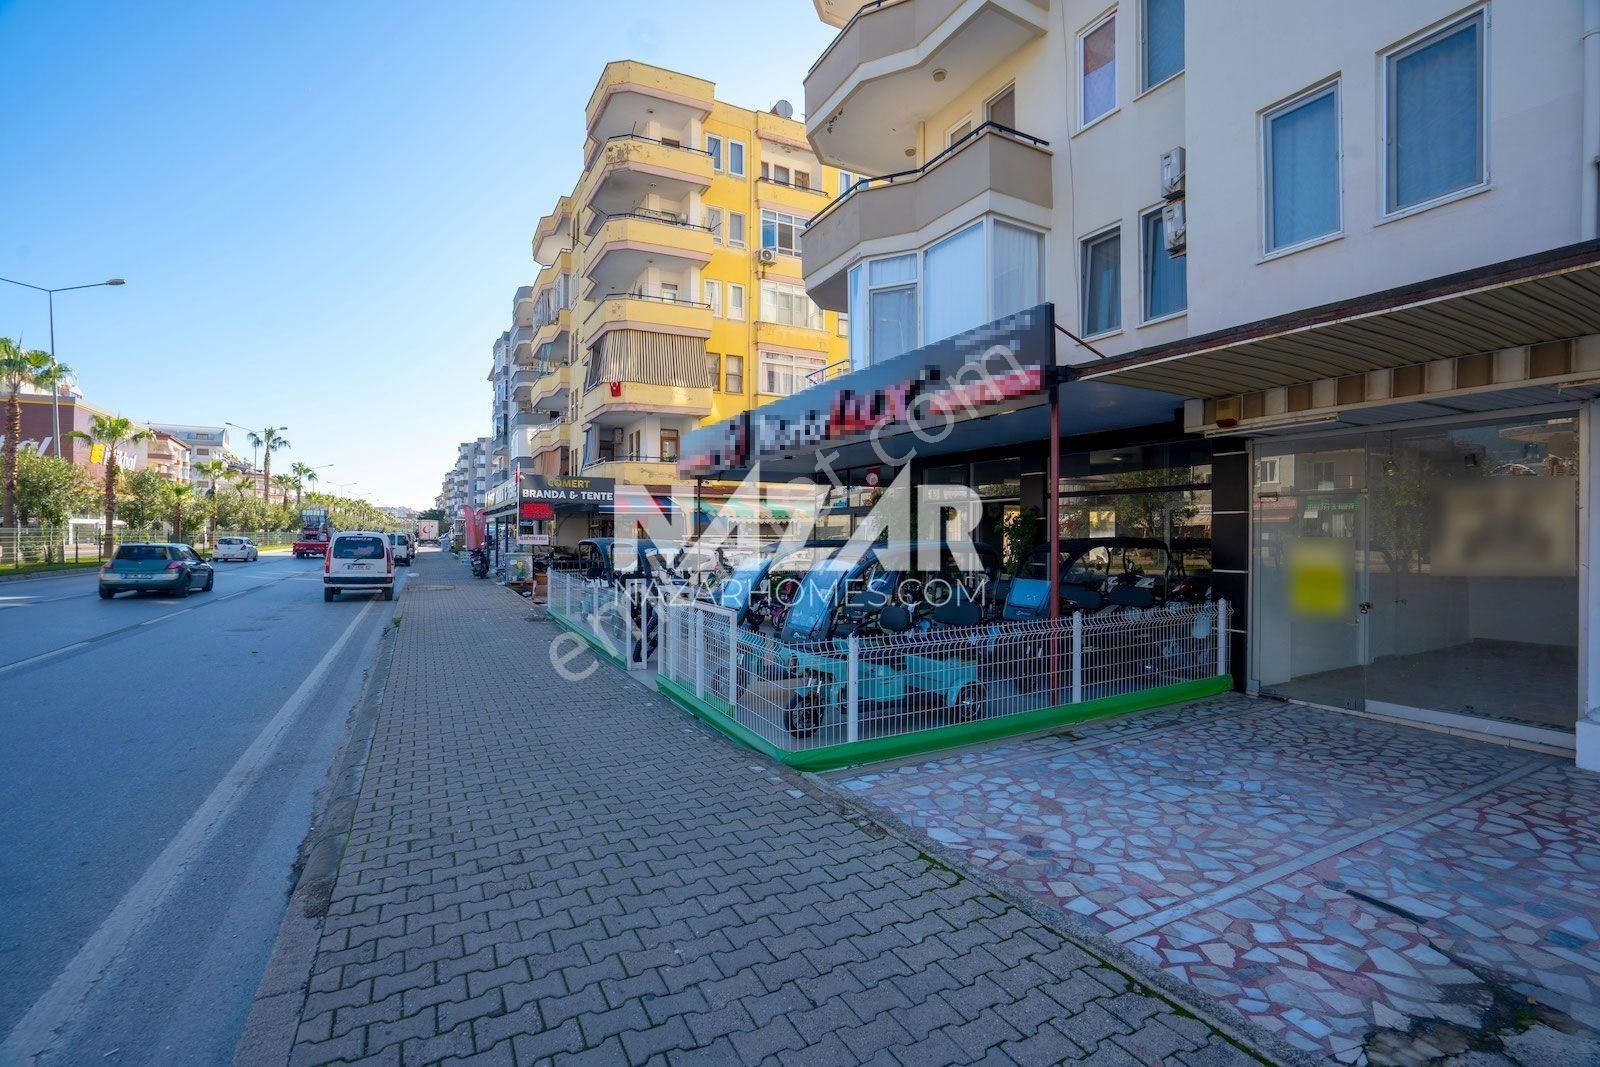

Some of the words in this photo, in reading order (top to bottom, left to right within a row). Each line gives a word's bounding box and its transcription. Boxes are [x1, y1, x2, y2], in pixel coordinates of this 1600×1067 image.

[522, 488, 567, 500] BRANDA
[569, 490, 578, 500] &
[580, 490, 614, 501] TENTE
